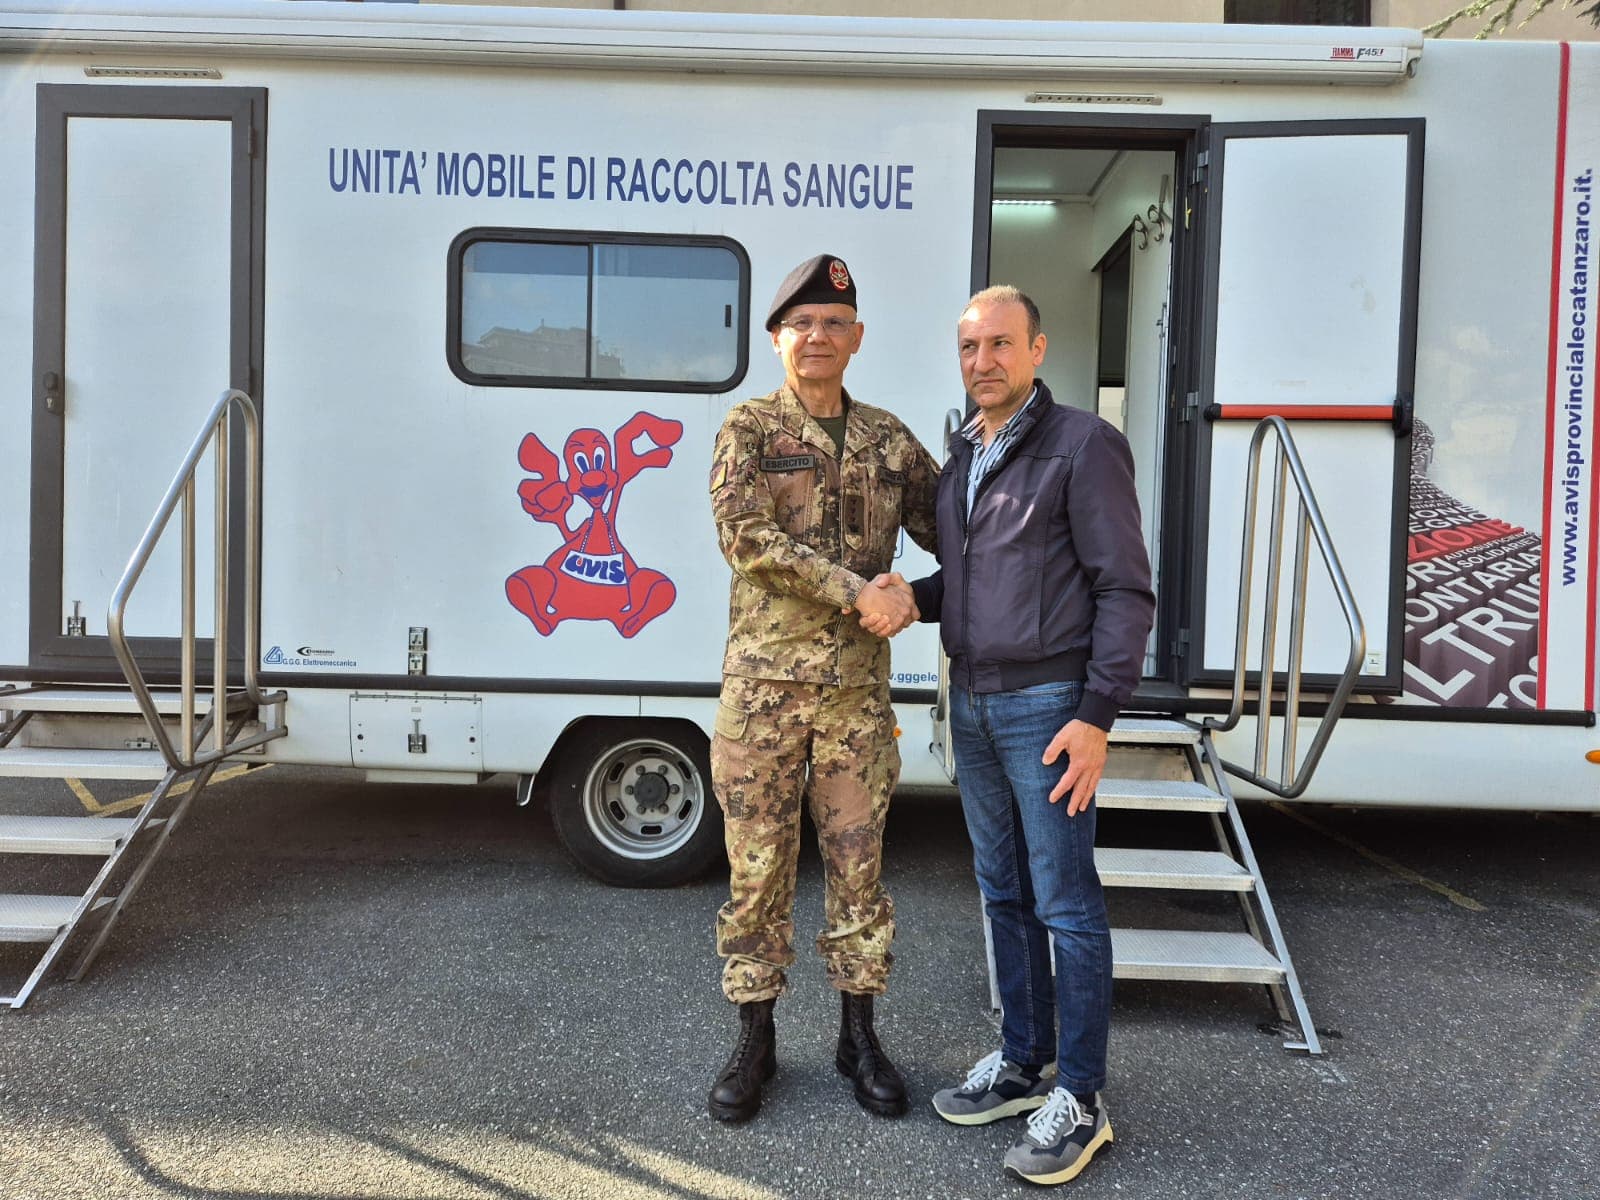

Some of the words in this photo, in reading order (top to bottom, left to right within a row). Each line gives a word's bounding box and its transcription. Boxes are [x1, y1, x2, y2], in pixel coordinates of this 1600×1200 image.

[437, 152, 556, 200] MOBILE
[567, 155, 596, 201] DI
[606, 157, 775, 206] RACCOLTA
[783, 162, 914, 210] SANGUE
[764, 457, 810, 469] ESERCITO
[1456, 536, 1542, 567] SOLIDARIET
[303, 658, 357, 667] Elettromeccanica
